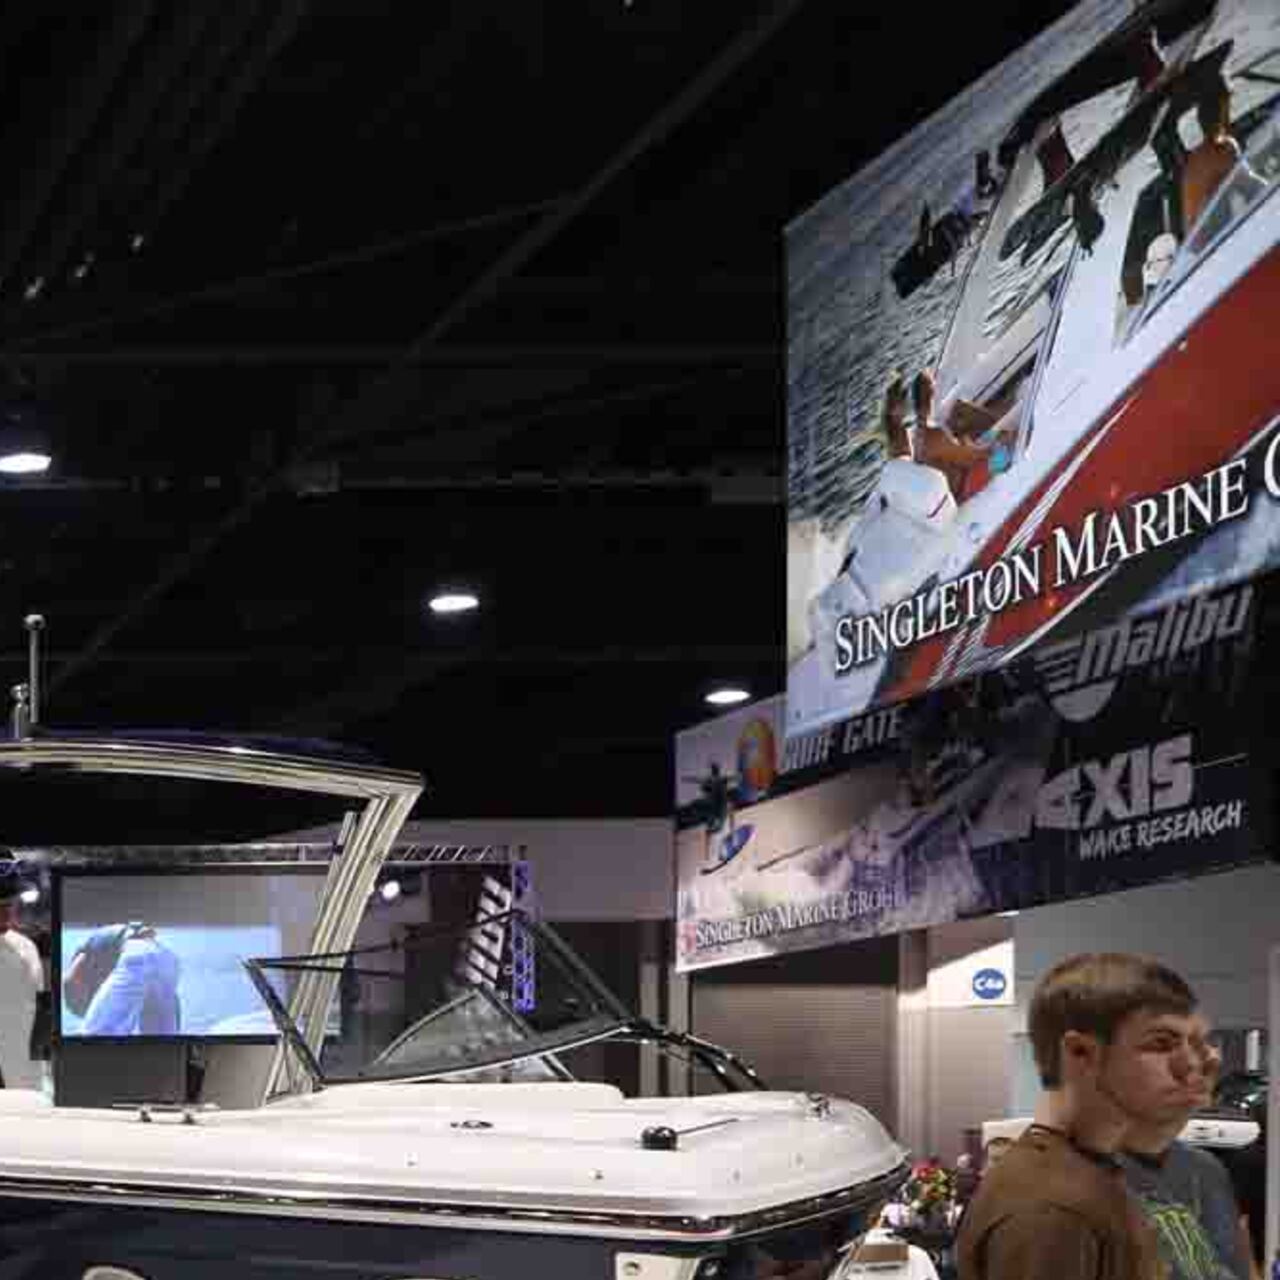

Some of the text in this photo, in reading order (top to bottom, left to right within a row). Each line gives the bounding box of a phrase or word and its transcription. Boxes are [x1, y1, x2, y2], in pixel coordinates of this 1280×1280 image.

[834, 546, 1043, 672] SINGLETON
[1052, 459, 1250, 587] MARINE
[1079, 801, 1242, 861] WAKE RESEARCH
